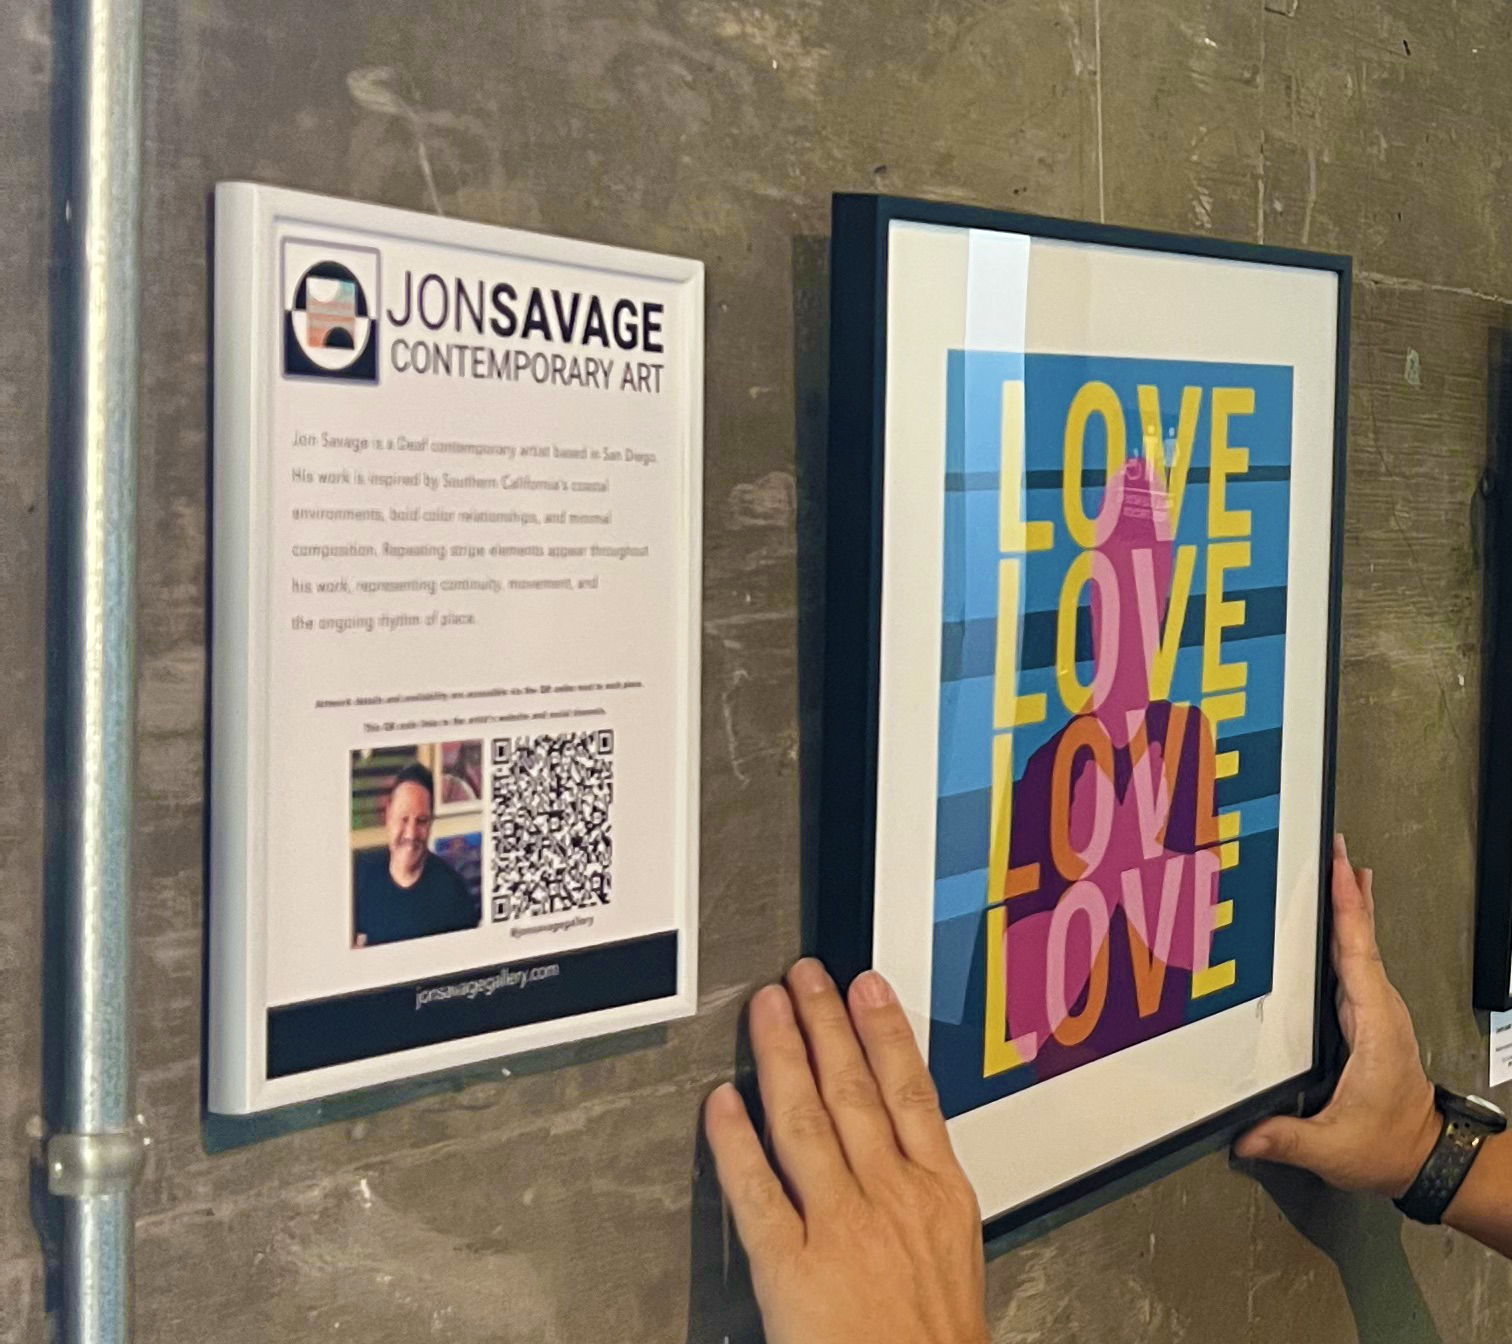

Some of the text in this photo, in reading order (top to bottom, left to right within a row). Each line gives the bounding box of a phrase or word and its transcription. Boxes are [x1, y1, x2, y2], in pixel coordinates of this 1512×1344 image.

[386, 269, 665, 354] JONSAVAGE
[390, 338, 665, 394] CONTEMPORARY ART
[292, 429, 317, 447] Jon
[321, 431, 368, 453] Savage
[292, 468, 314, 484] His
[318, 469, 350, 484] work
[998, 379, 1256, 553] LOVE
[993, 541, 1252, 730] LOVE
[987, 691, 1247, 905] LOVE
[415, 963, 561, 1011] jonsavagegallery.com
[983, 840, 1240, 1079] LOVE
